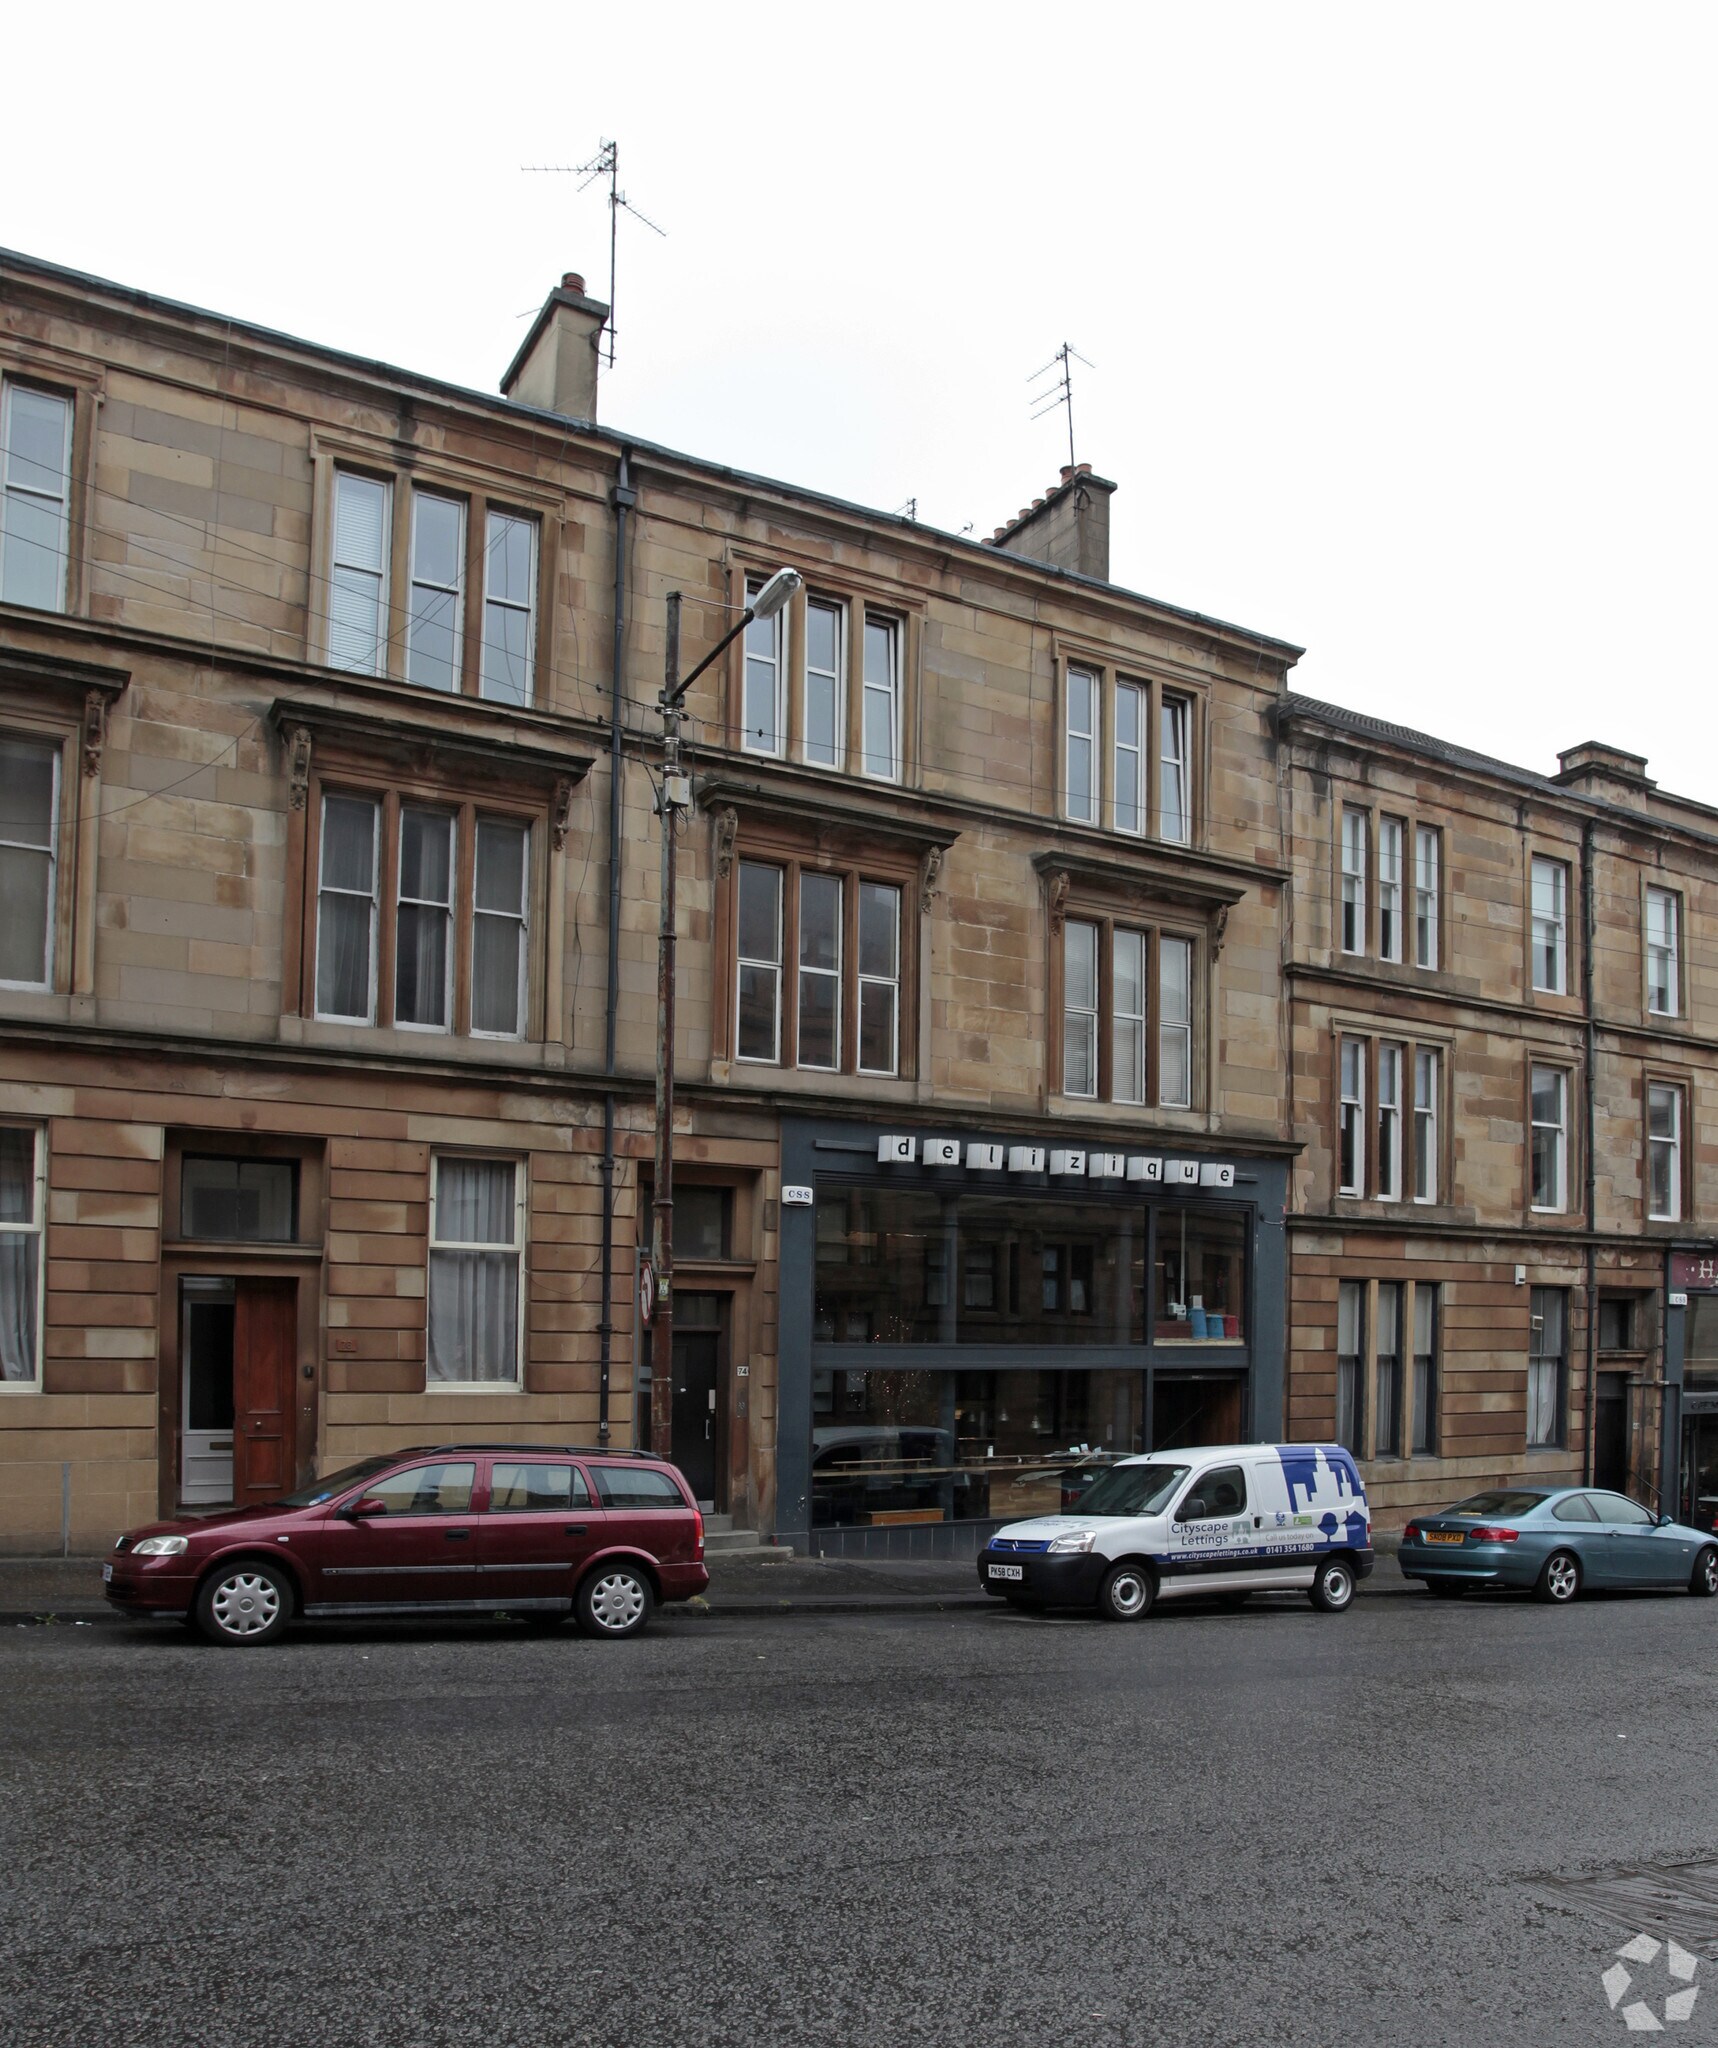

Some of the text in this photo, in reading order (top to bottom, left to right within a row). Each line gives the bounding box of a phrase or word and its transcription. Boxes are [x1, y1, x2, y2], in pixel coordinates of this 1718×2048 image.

[897, 1138, 1230, 1182] delizique
[788, 1190, 810, 1199] CSS
[1698, 1260, 1718, 1278] H
[738, 1367, 748, 1375] 74
[1171, 1522, 1229, 1536] Cityscape
[1181, 1534, 1229, 1547] Lettings
[1265, 1534, 1278, 1542] Call
[1287, 1532, 1304, 1542] today
[1170, 1547, 1258, 1560] www.cityscapelettings.co.uk
[1265, 1543, 1314, 1554] 0141 354 1680
[990, 1567, 1021, 1577] PK58 CXH
